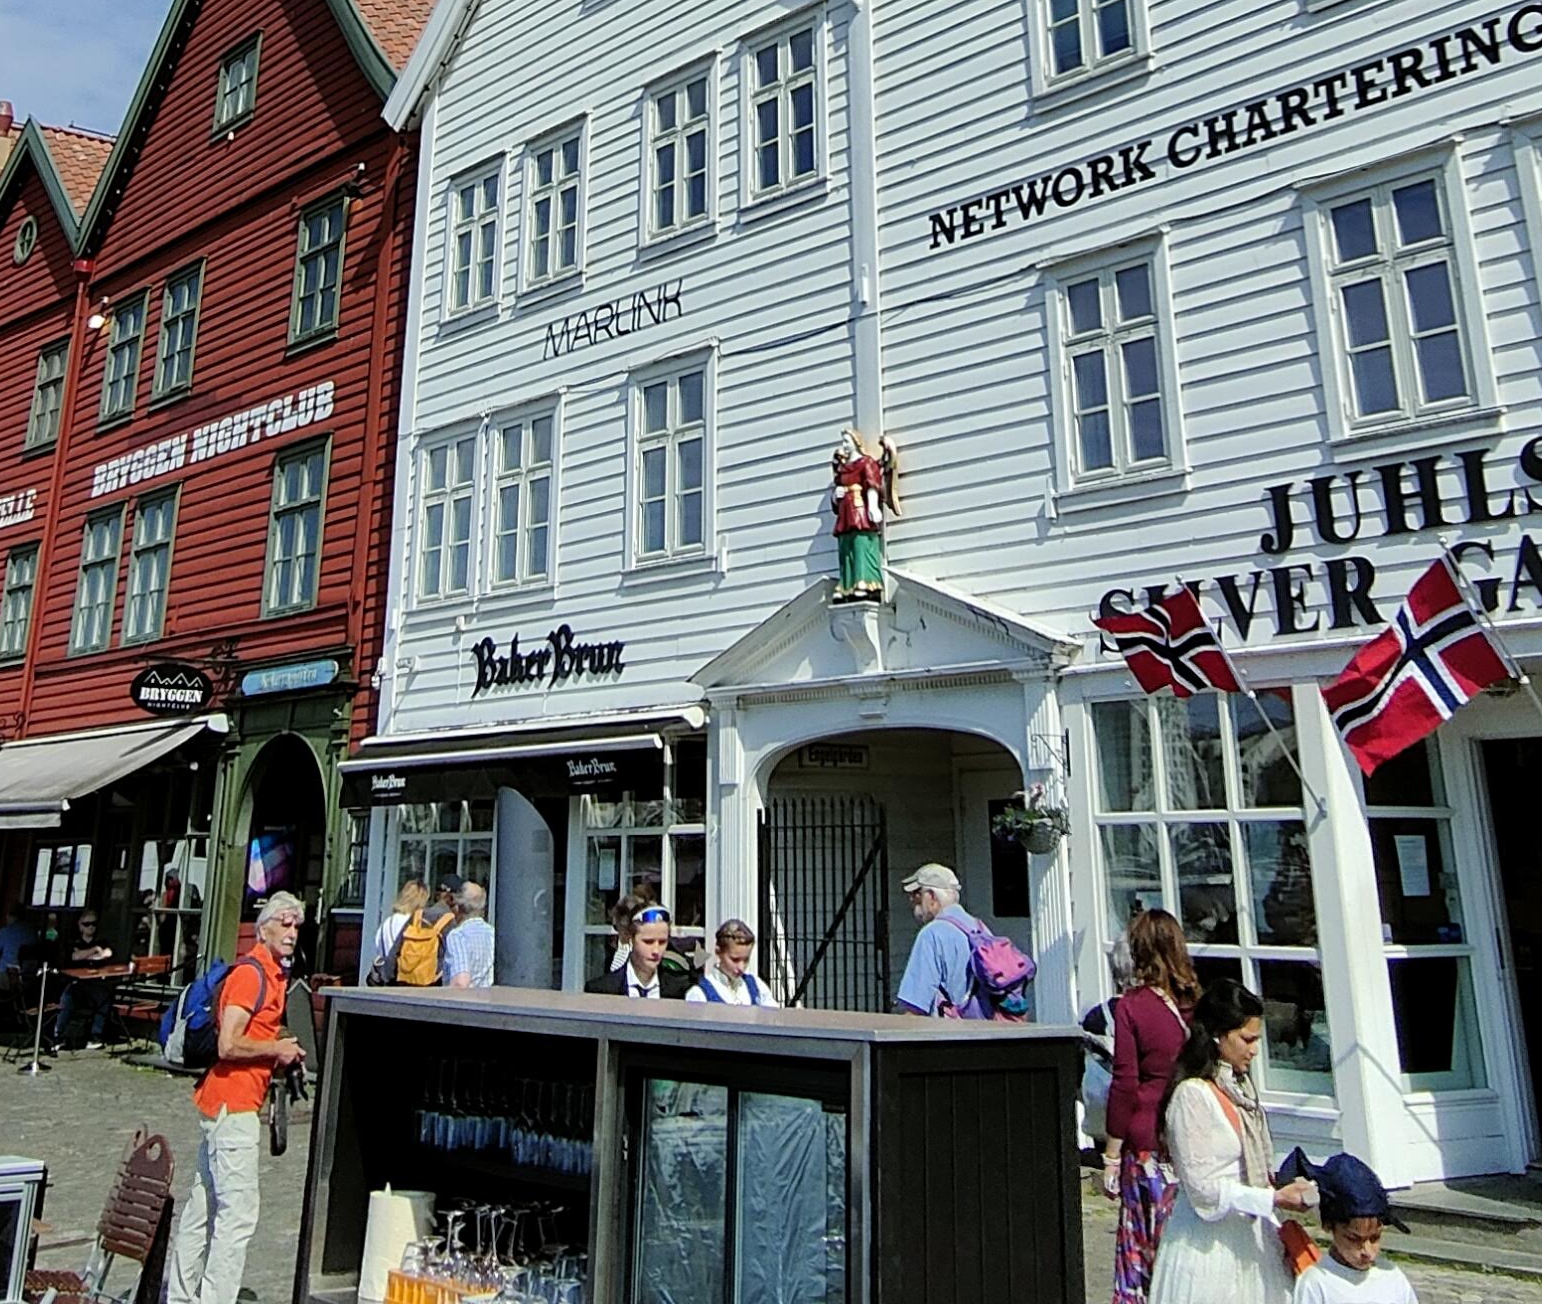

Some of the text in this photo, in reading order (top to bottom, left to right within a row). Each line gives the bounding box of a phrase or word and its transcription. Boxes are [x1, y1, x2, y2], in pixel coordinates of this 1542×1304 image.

[929, 140, 1156, 250] NETWORK
[542, 278, 684, 361] MARLINK
[91, 381, 335, 498] BRYGGEN NIGHTCLUB
[139, 687, 203, 703] BRYGGEN
[471, 623, 626, 699] Baker Brun
